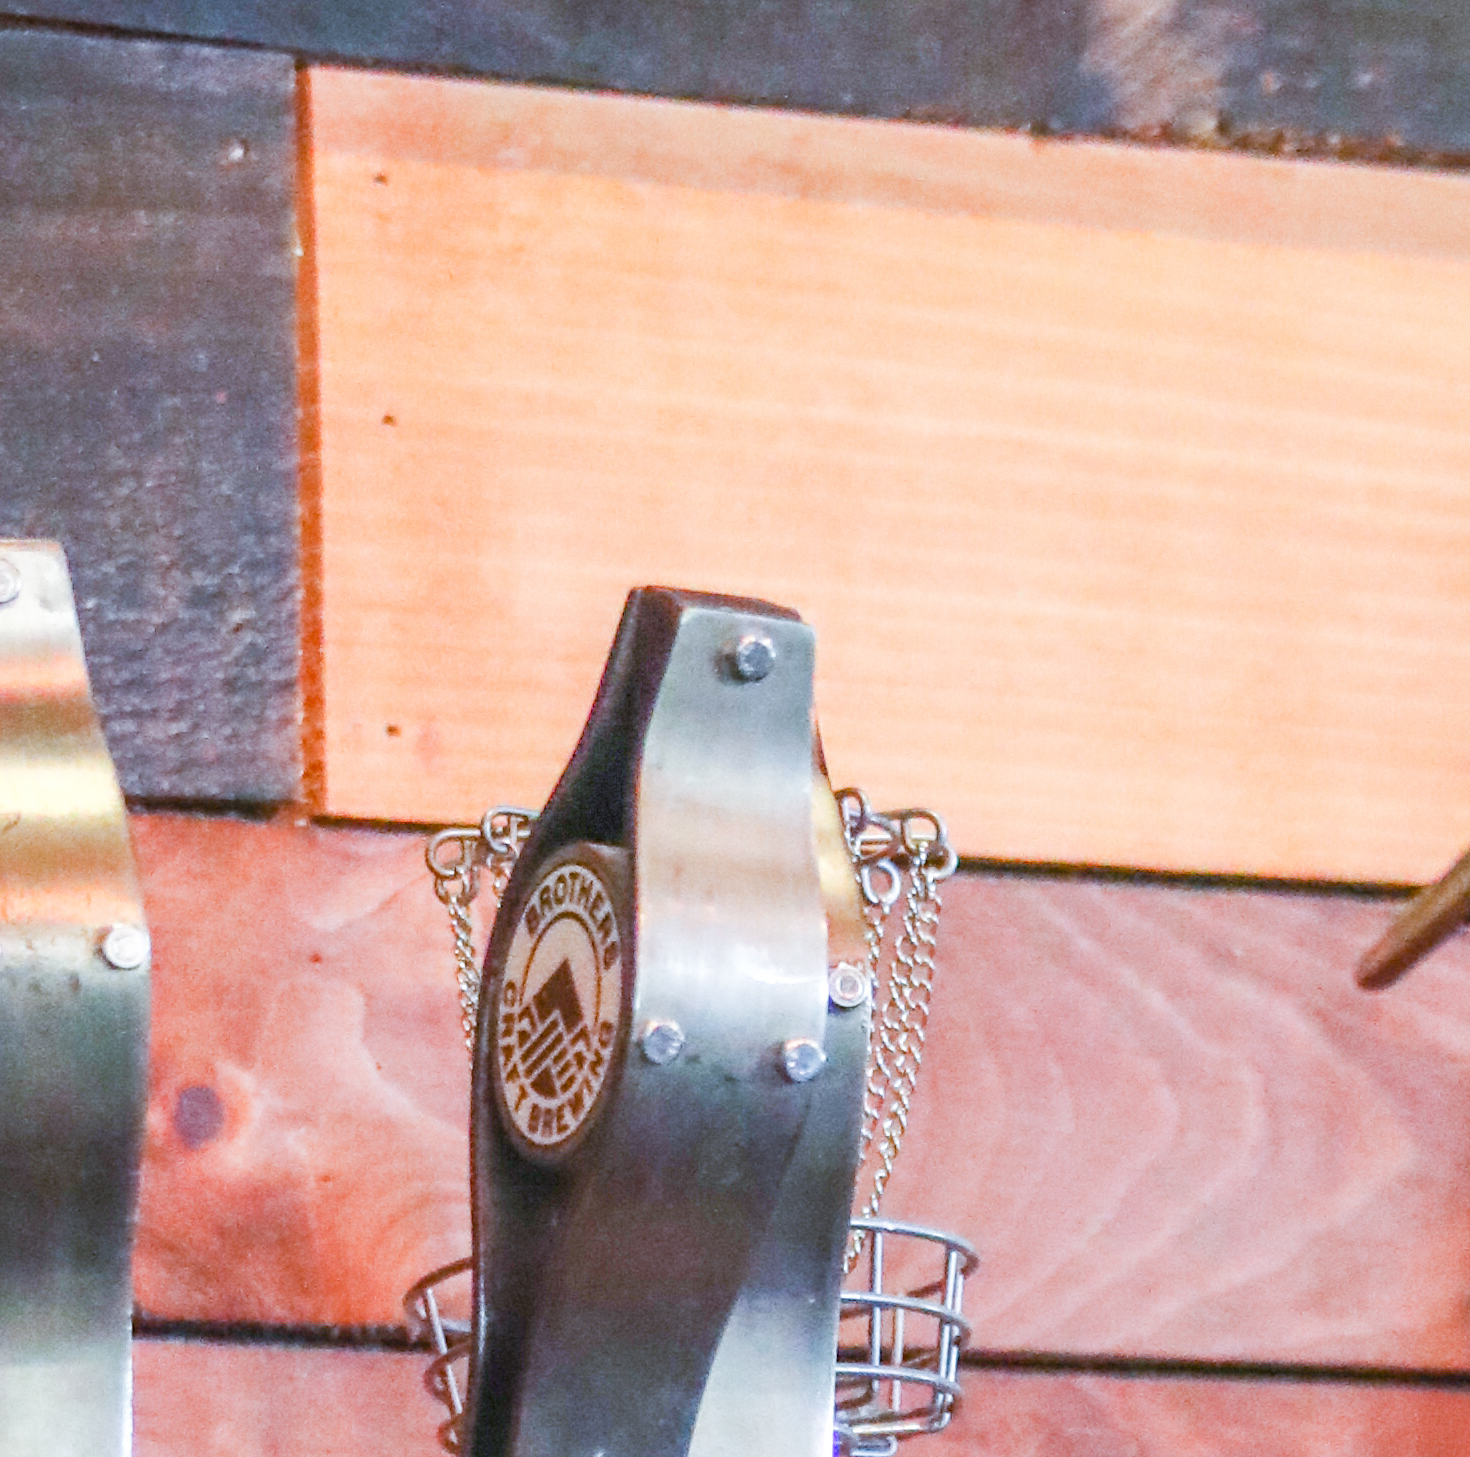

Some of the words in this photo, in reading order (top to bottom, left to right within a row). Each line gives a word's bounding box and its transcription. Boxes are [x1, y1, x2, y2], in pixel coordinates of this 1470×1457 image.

[525, 869, 619, 971] BROTHERS
[501, 980, 528, 1113] CRAFT
[528, 1020, 614, 1137] BREWING
